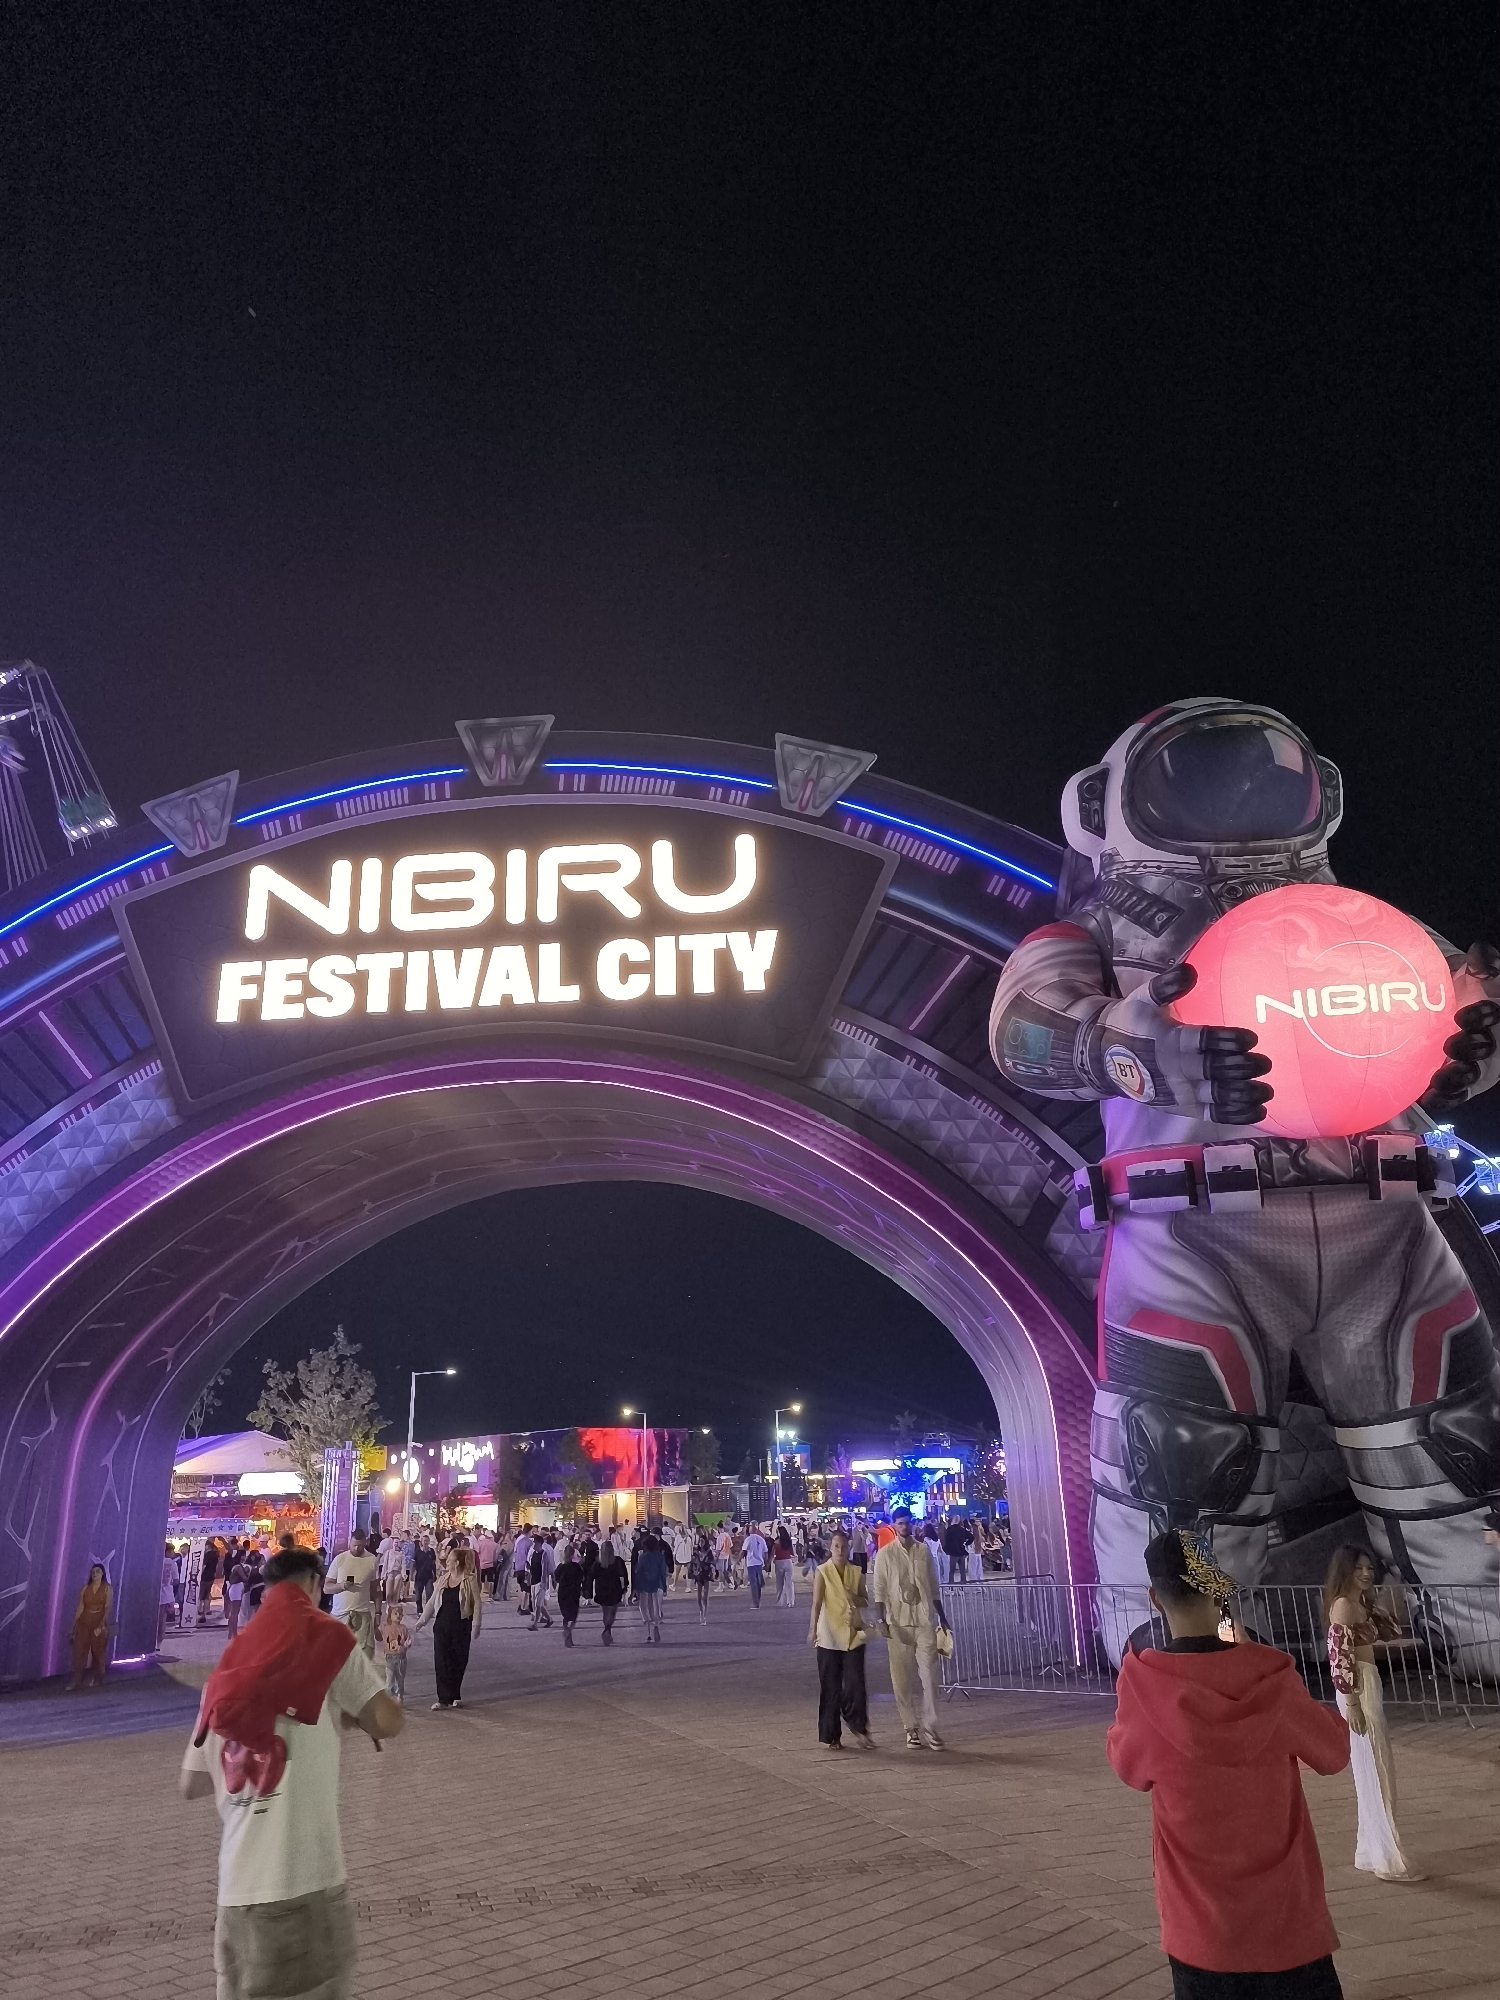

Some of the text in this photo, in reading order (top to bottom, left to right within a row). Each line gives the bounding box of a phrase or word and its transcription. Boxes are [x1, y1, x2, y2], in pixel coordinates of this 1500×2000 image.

[244, 833, 757, 941] NIBIRU
[215, 929, 779, 1024] FESTIVAL CITY
[1255, 981, 1446, 1023] NIBIRU
[1117, 1062, 1135, 1079] BT
